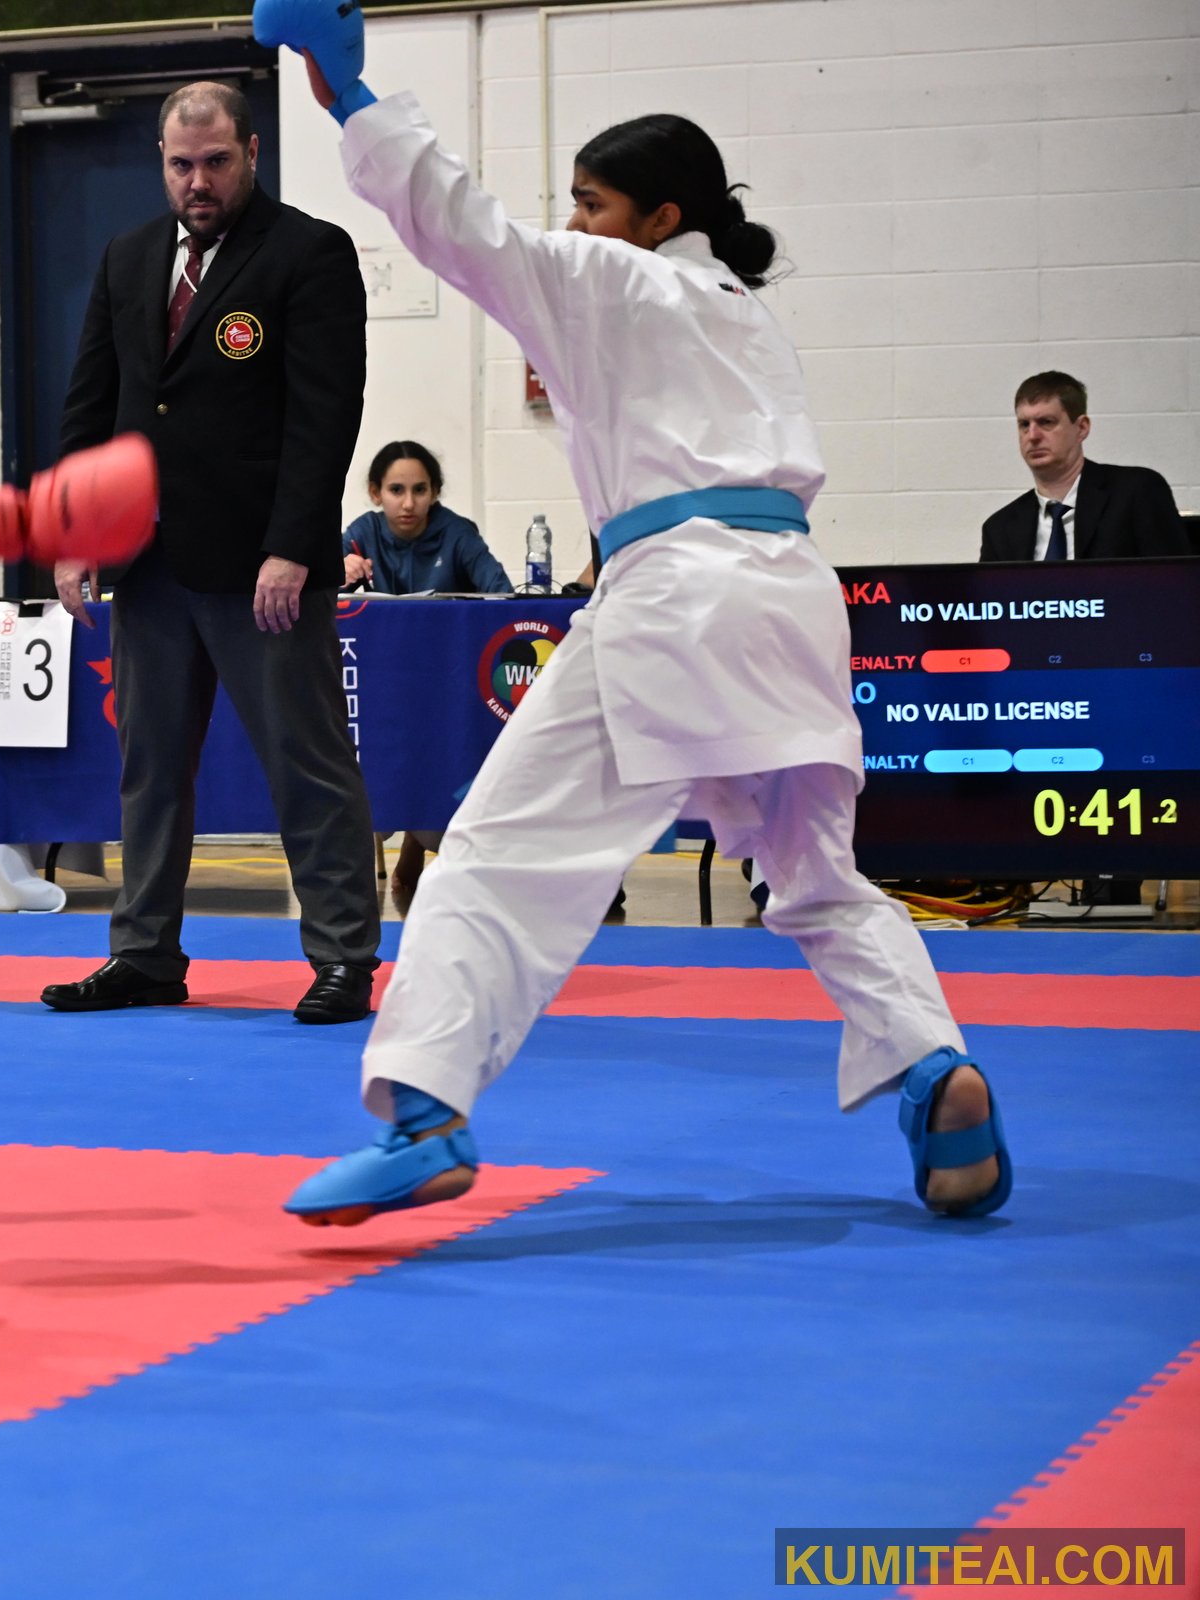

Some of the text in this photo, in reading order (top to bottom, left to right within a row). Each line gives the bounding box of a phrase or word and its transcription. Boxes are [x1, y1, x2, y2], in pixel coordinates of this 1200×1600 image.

[900, 599, 1105, 622] NO VALID LICENSE
[513, 622, 549, 634] WORLD
[23, 638, 53, 701] 3
[850, 653, 1153, 670] ENALTY C1 C2 C3
[505, 665, 540, 685] WK
[850, 682, 877, 704] O
[487, 698, 512, 720] KARA
[886, 701, 1090, 722] NO VALID LICENSE
[861, 755, 1155, 769] NALTY C1 C2 C3
